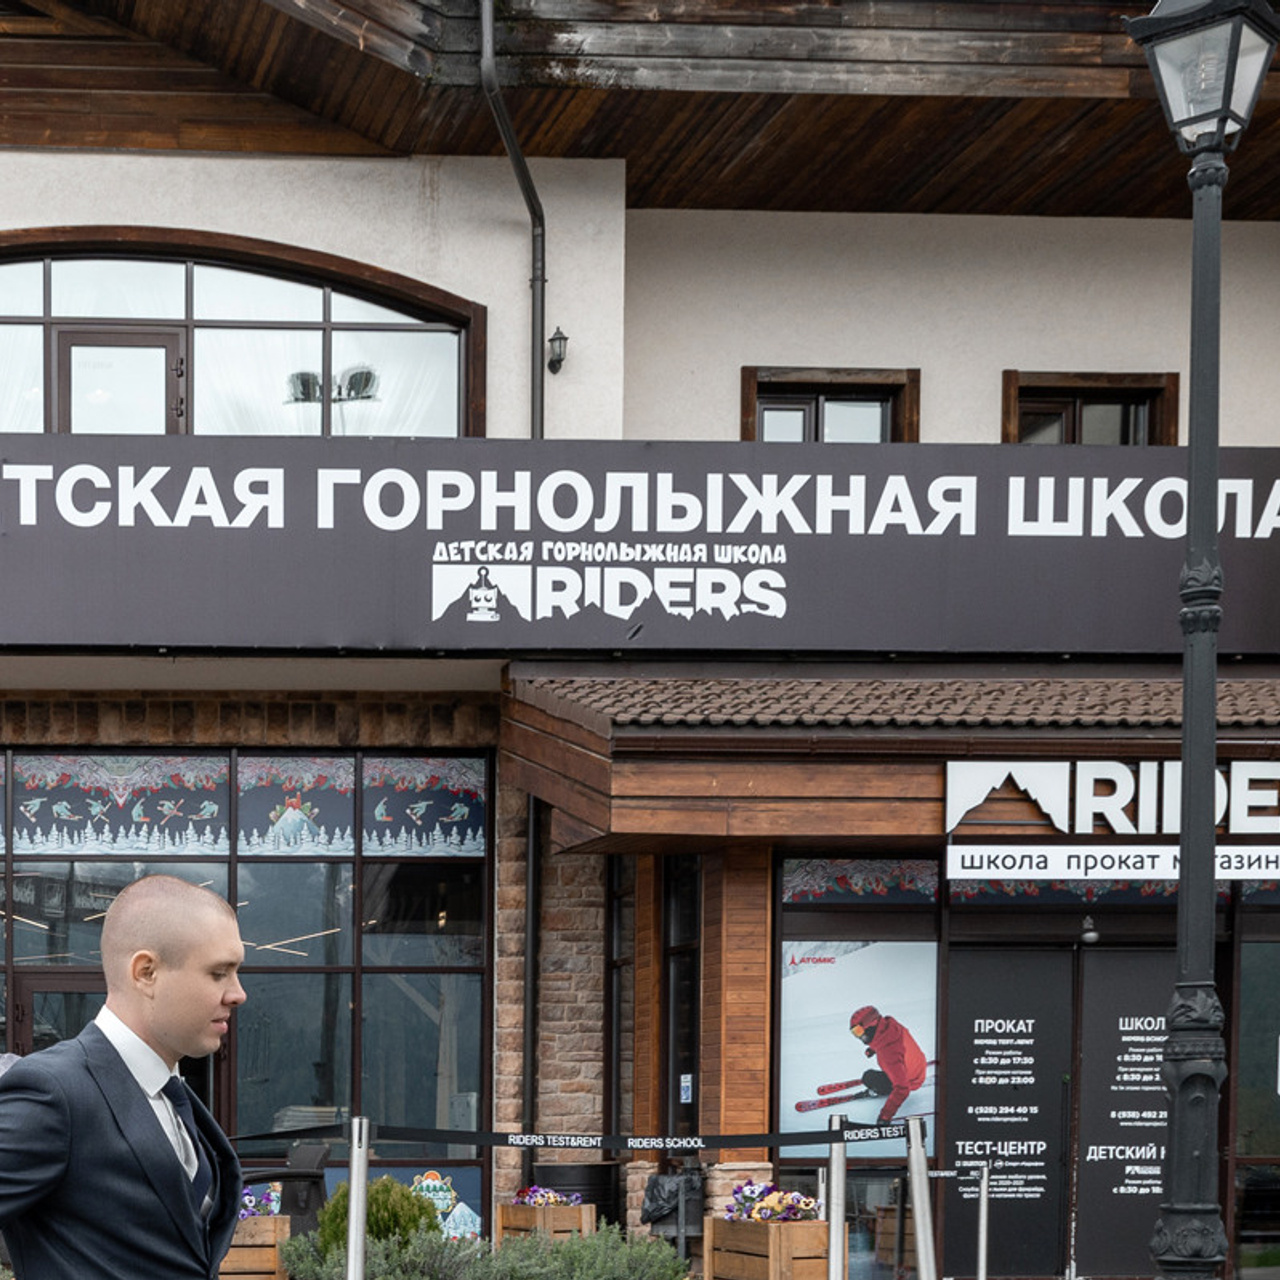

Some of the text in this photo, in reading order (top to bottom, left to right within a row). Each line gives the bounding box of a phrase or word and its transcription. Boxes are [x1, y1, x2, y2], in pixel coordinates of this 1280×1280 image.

[318, 469, 976, 535] ГОРНОЛЫЖНАЯ
[433, 541, 787, 564] ДЕТСКАЯ ГОРНОЛЫЖНАЯ ШКОЛА
[536, 567, 787, 621] RIDERS
[961, 854, 1280, 876] школа прокат азин
[800, 956, 836, 964] ATOMIC
[974, 1019, 1035, 1033] ПРОКАТ
[1119, 1016, 1166, 1030] ШКОЛ
[508, 1134, 603, 1148] RIDERS TEST&RENT
[843, 1125, 906, 1141] RIDERS TEST
[627, 1138, 706, 1149] RIDERS SCHOOL
[956, 1141, 1047, 1157] ТЕСТ-ЦЕНТР
[1086, 1143, 1157, 1162] ДЕТСКИЙ
